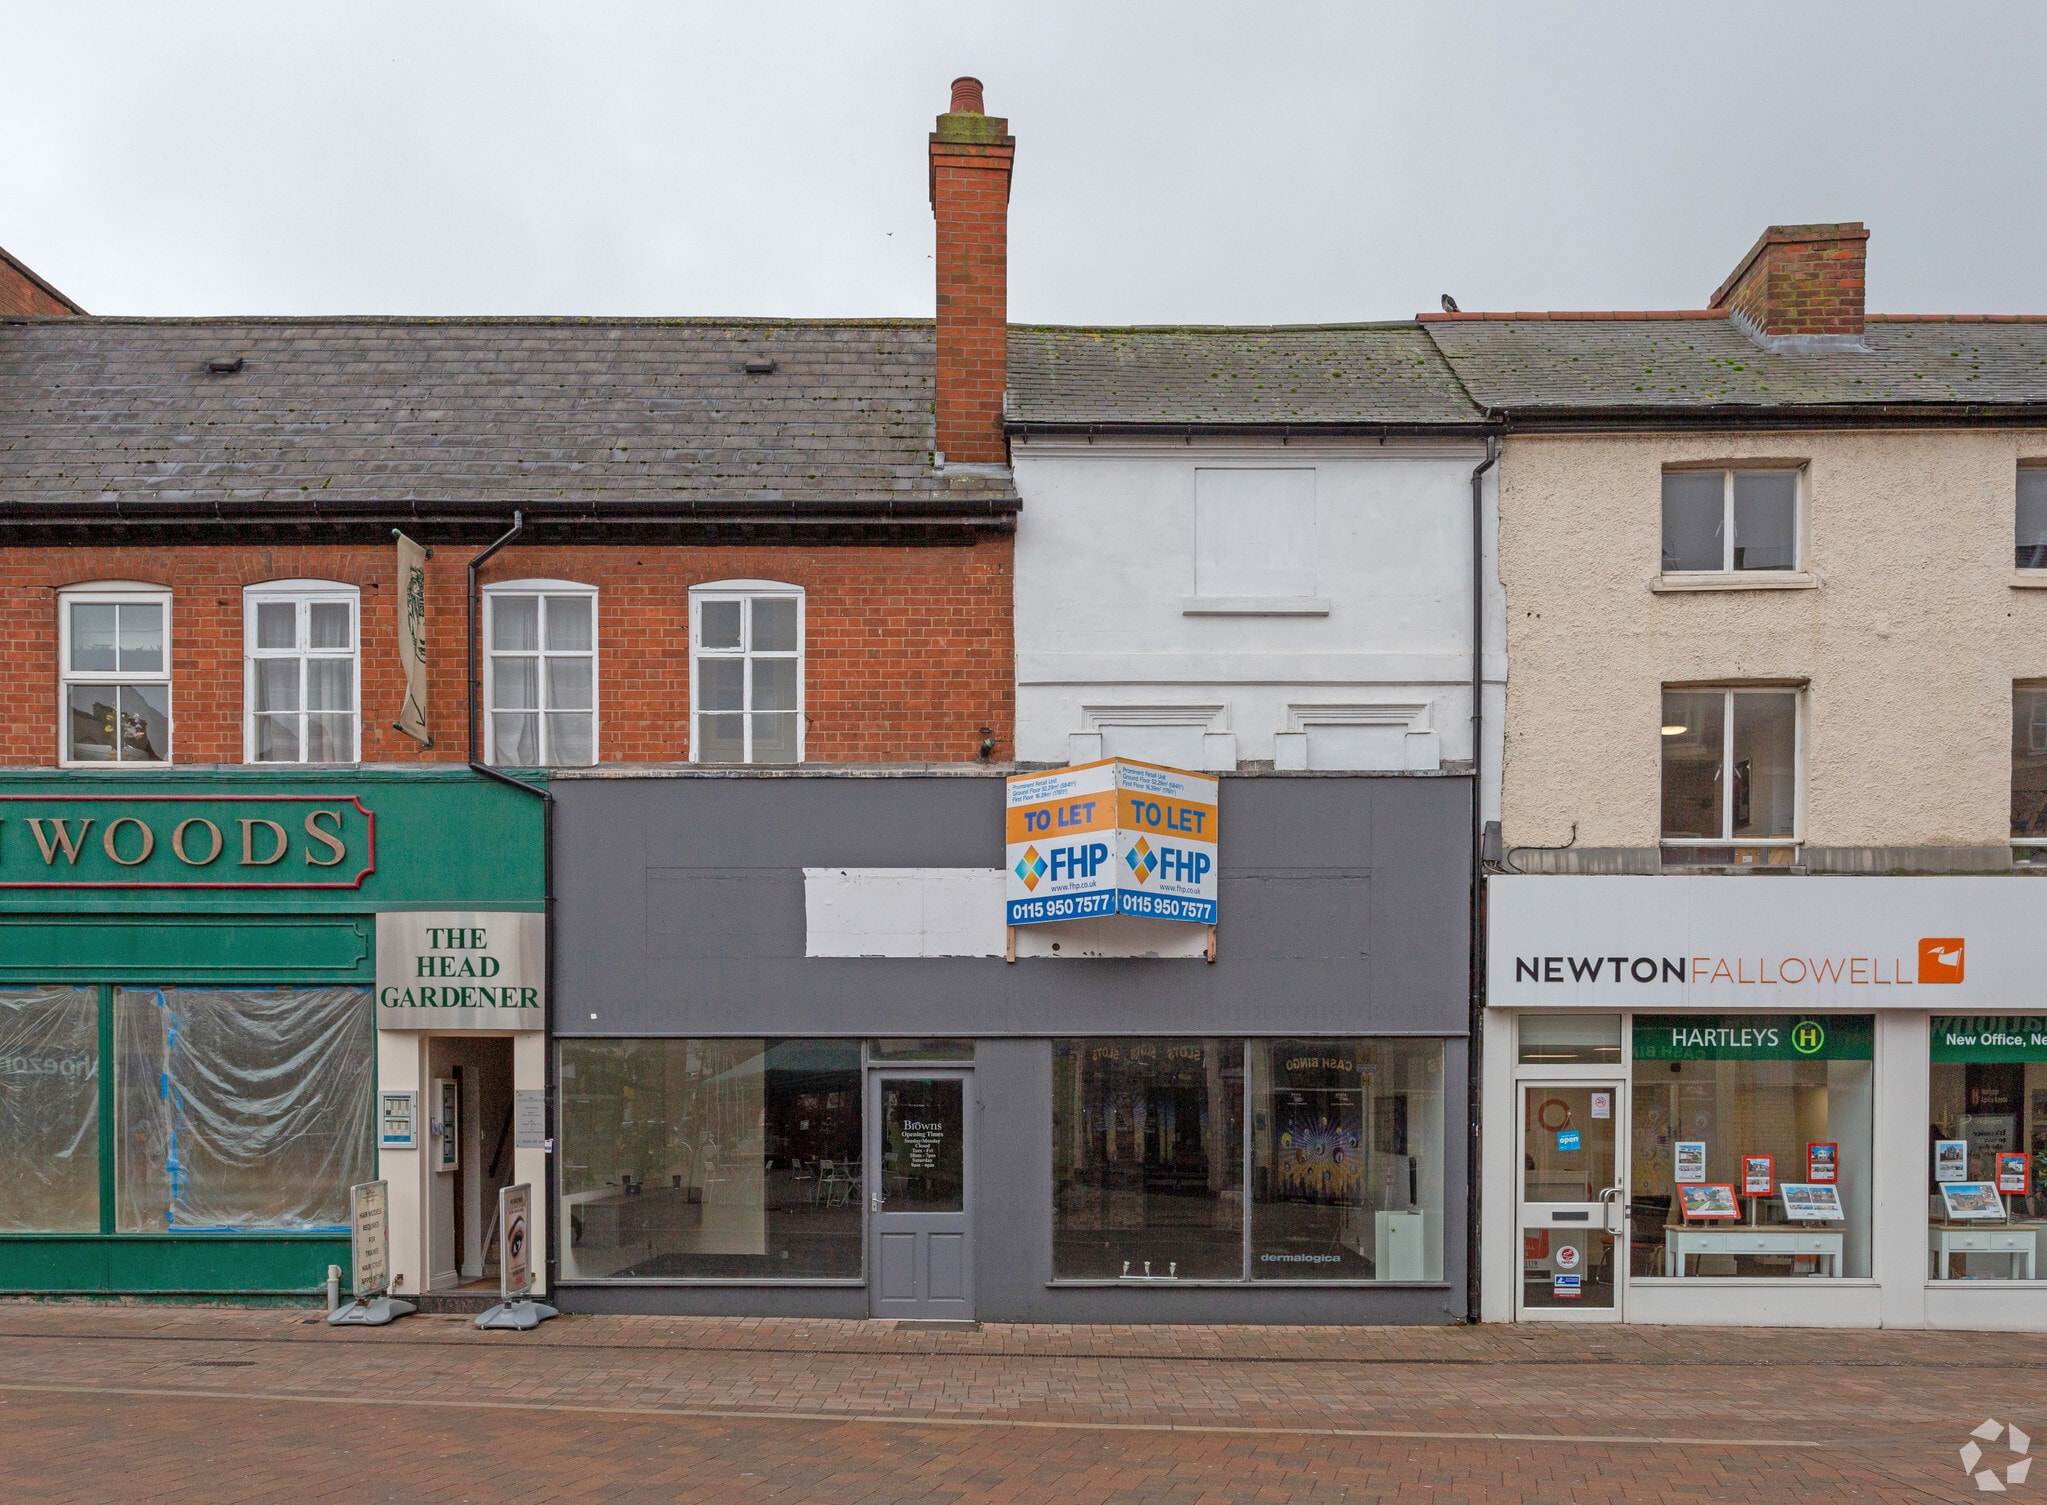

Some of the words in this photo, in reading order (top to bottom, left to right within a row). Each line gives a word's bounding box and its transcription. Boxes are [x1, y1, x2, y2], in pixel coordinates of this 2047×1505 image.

[1024, 809, 1051, 833] TO
[1057, 801, 1096, 828] LET
[1131, 799, 1161, 826] TO
[1167, 806, 1206, 834] LET
[0, 809, 347, 867] WOODS
[1050, 843, 1108, 882] FHP
[1160, 846, 1211, 884] FHP
[1050, 880, 1097, 892] www.fhp.co.uk
[1159, 884, 1201, 895] www.fhp.co.uk
[1012, 902, 1044, 920] 0115
[1046, 899, 1074, 916] 950
[1075, 894, 1110, 913] 7577
[1122, 894, 1152, 913] 0115
[1153, 898, 1180, 916] 950
[1181, 901, 1212, 919] 7577
[426, 928, 488, 949] THE
[416, 956, 500, 978] HEAD
[380, 986, 541, 1009] GARDENER
[1672, 1028, 1779, 1047] HARTLEYS
[1799, 1028, 1817, 1047] H
[1946, 1033, 1976, 1046] New
[1980, 1033, 2027, 1048] Office,
[904, 1120, 943, 1130] Browns
[1559, 1135, 1579, 1145] open
[1260, 1253, 1341, 1264] dermalogica
